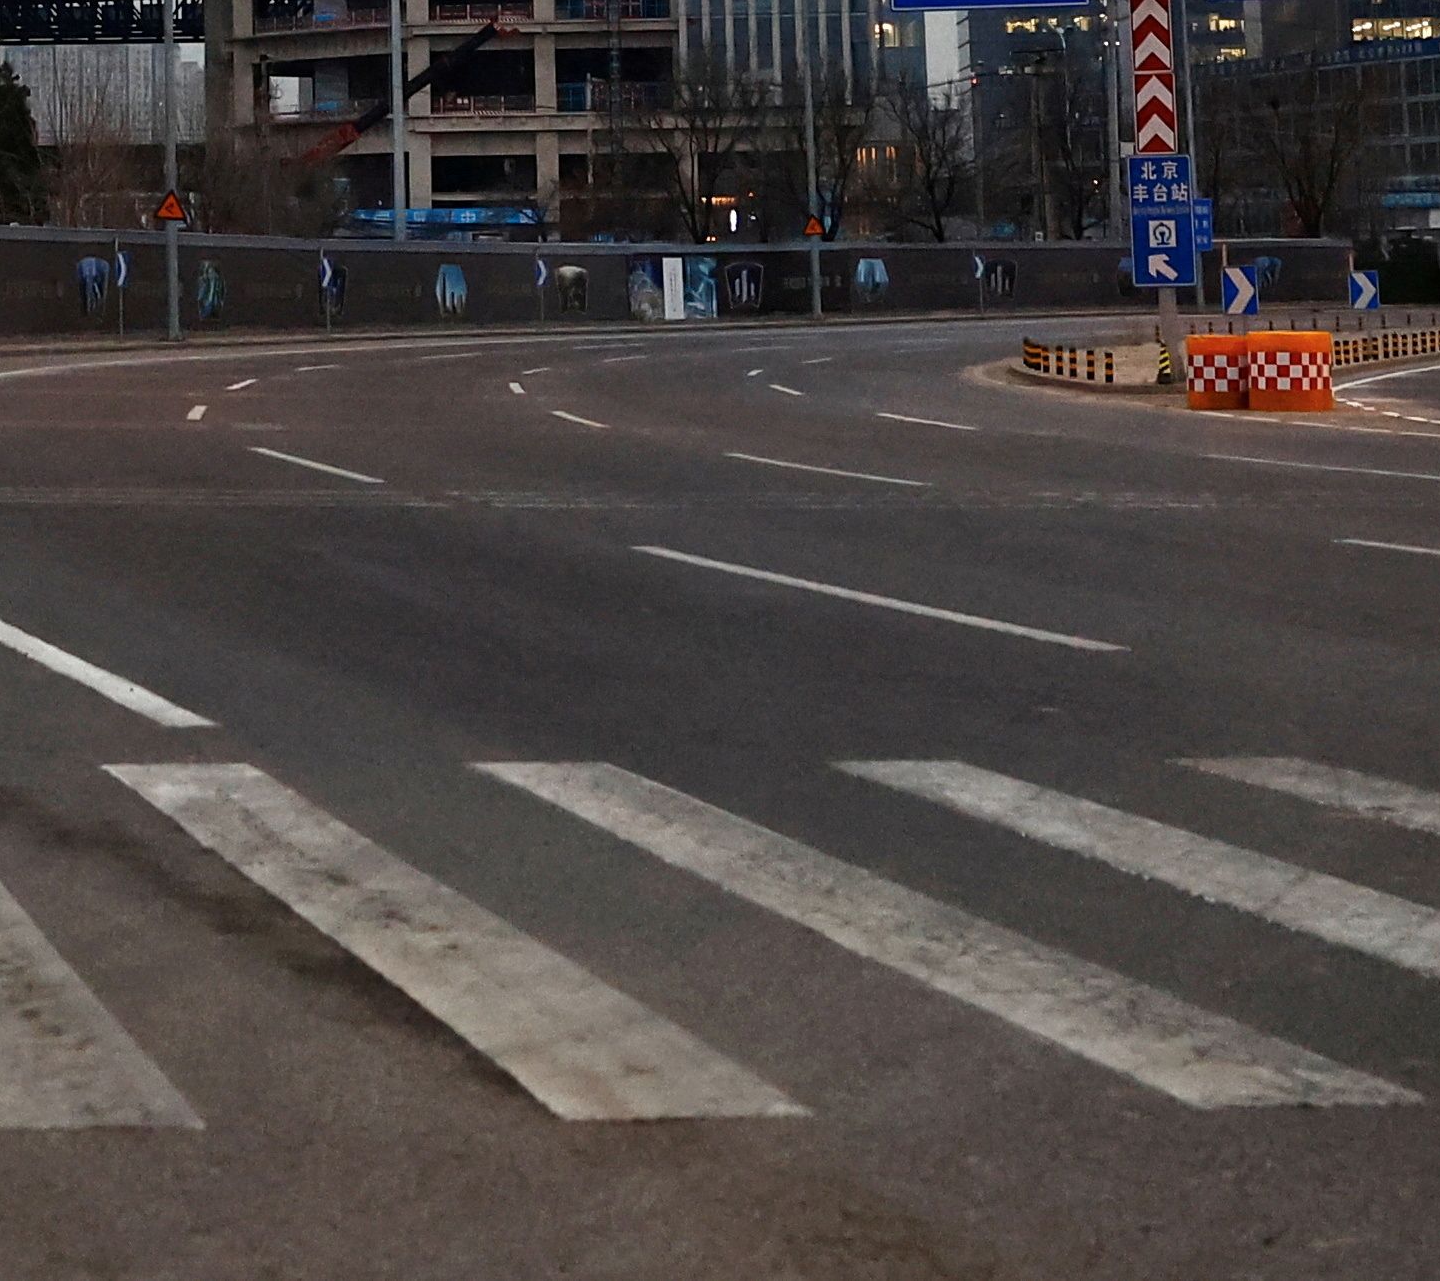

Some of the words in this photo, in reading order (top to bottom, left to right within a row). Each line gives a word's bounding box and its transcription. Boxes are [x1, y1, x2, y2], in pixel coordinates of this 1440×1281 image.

[1141, 161, 1178, 181] 北京
[1132, 182, 1189, 203] 丰台站
